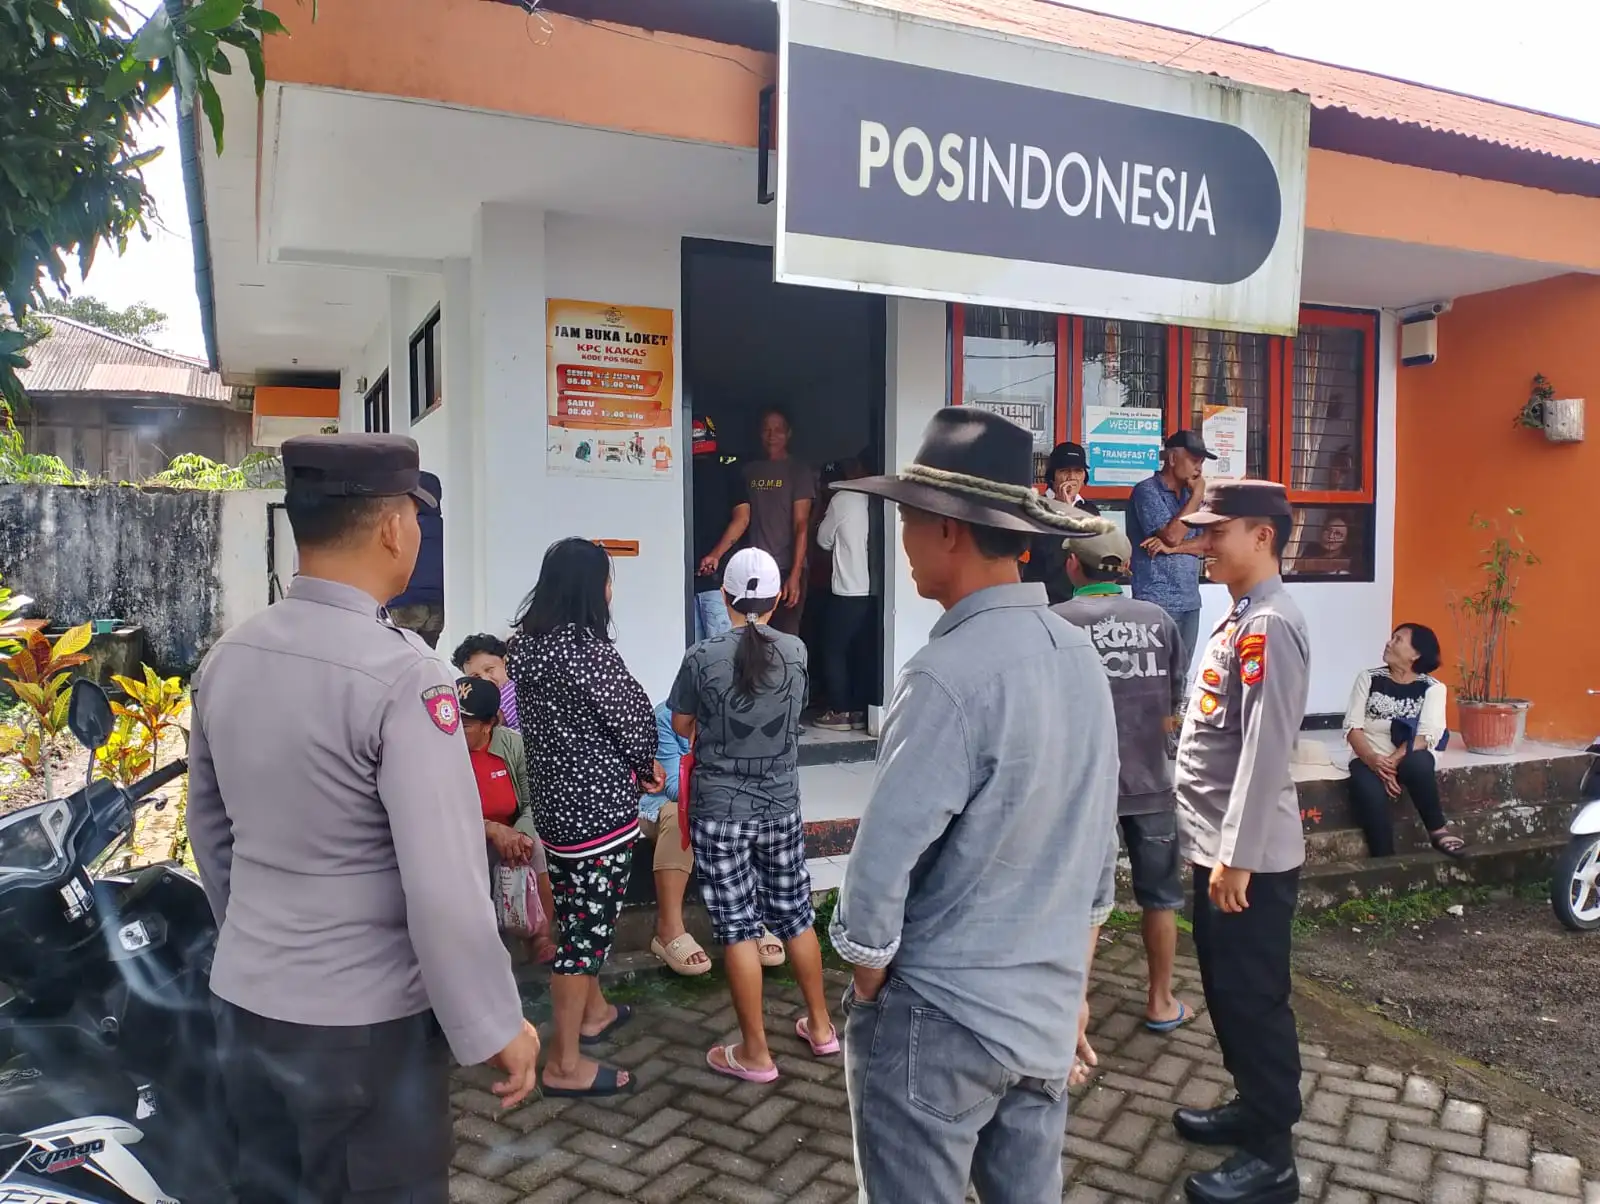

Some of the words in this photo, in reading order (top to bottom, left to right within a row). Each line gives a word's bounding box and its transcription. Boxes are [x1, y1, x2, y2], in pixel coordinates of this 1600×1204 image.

[555, 325, 581, 339] JAM
[585, 328, 621, 342] BUKA
[625, 332, 668, 346] LOKET
[577, 343, 601, 353] KPC
[605, 346, 647, 357] KAKAS
[581, 353, 601, 361] KODE
[603, 355, 619, 363] POS
[567, 399, 595, 408] SABTU
[1101, 449, 1146, 459] TRANSFAST
